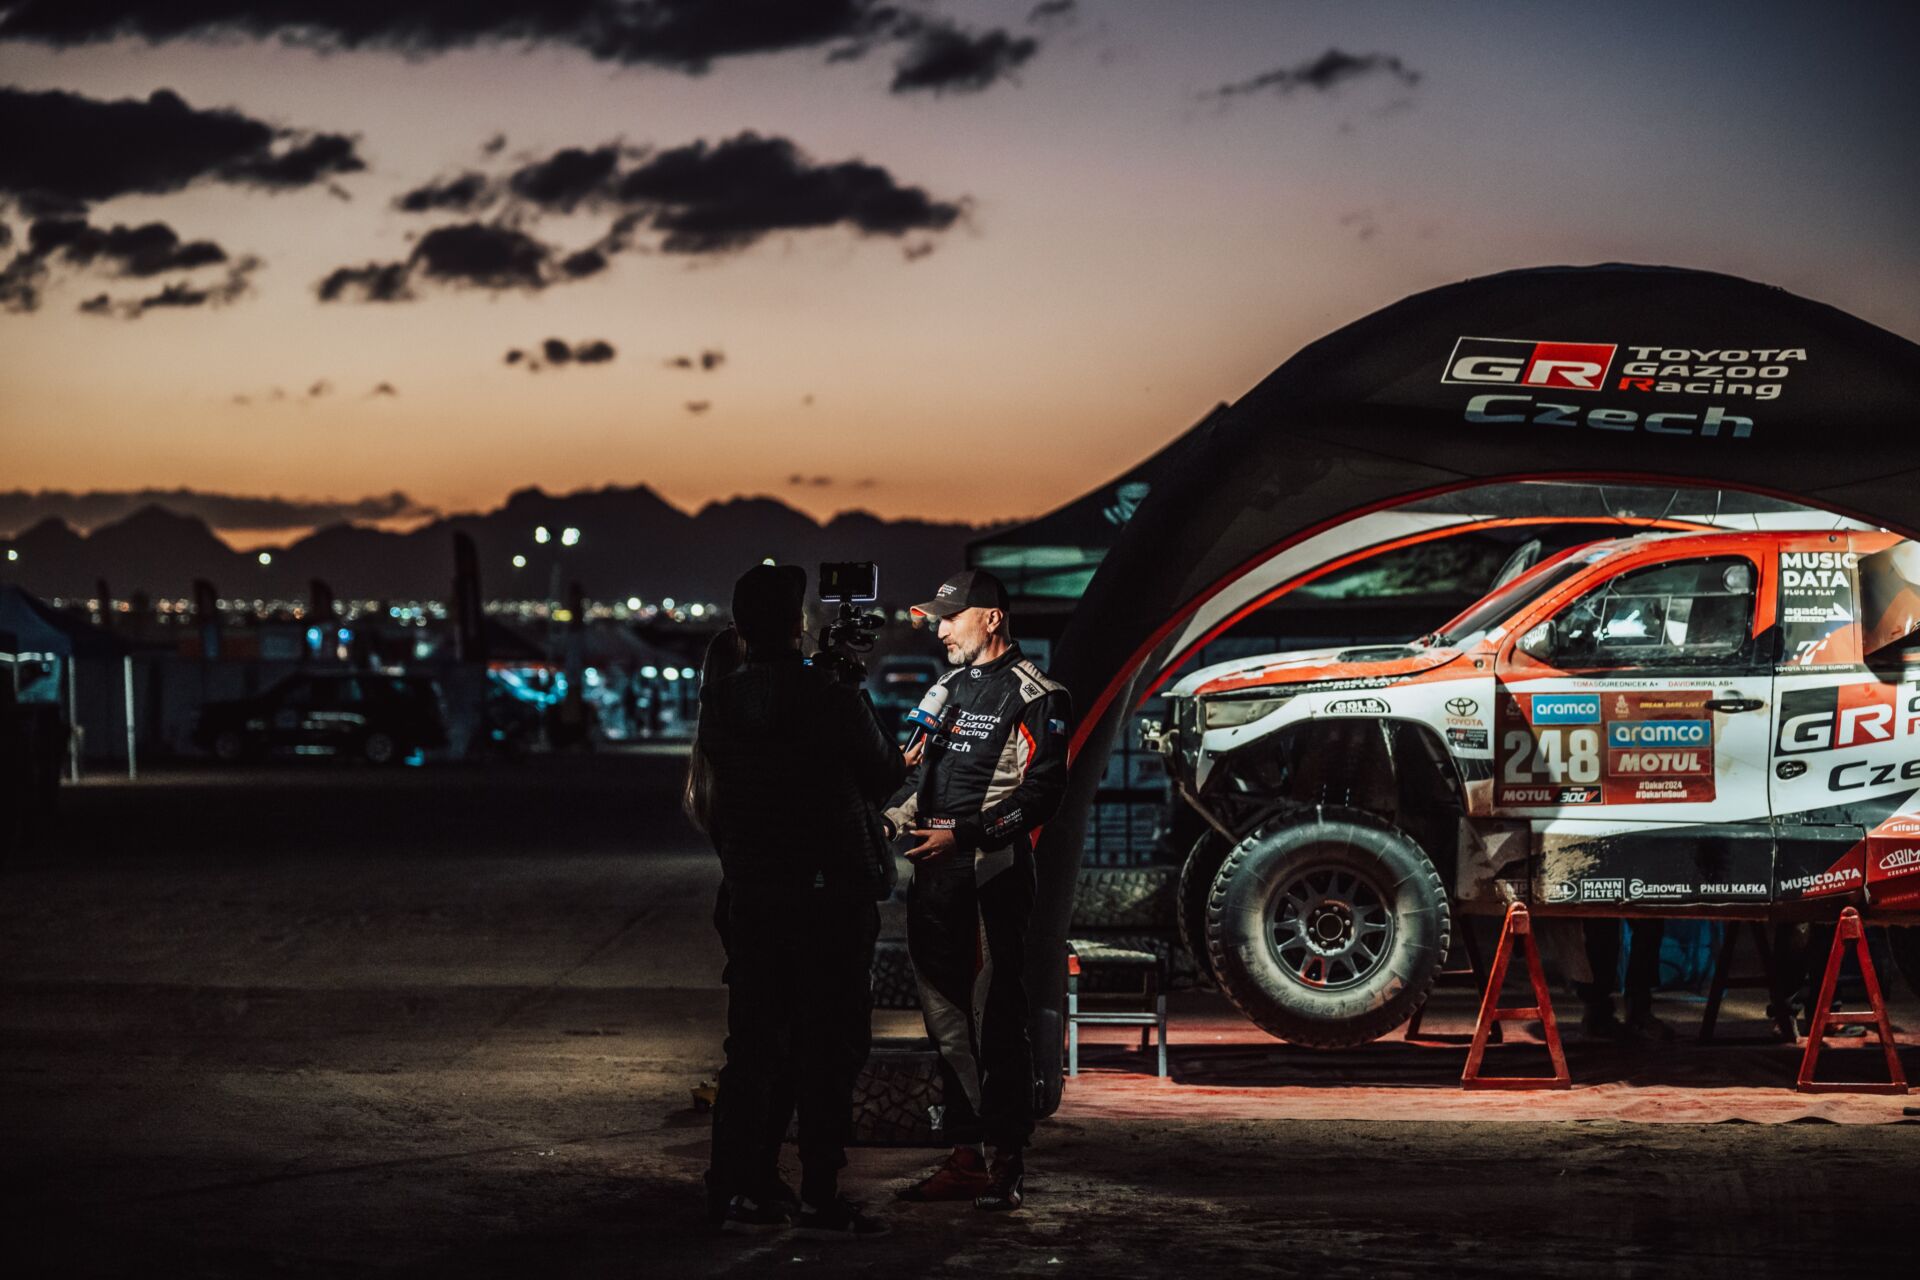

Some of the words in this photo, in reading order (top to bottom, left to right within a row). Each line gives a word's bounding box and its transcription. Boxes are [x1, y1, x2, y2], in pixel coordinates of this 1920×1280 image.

[1628, 346, 1807, 362] TOYOTA
[1452, 356, 1602, 388] GR
[1622, 362, 1789, 378] GAZOO
[1618, 377, 1782, 400] Racing
[1465, 394, 1754, 438] Czech
[1781, 553, 1858, 569] MUSIC
[1782, 570, 1850, 587] DATA
[960, 710, 1001, 724] TOYOTA
[1536, 703, 1597, 715] aramco
[955, 718, 995, 730] GAZOO
[1446, 718, 1484, 727] TOYOTA
[1780, 704, 1893, 752] GR
[951, 725, 990, 740] Racing
[1615, 726, 1704, 742] aramco
[1503, 729, 1600, 783] 248
[1618, 752, 1702, 772] MOTUL
[1639, 780, 1683, 790] #Dakar2024
[1502, 790, 1552, 801] MOTUL
[1560, 790, 1599, 803] 300V
[1583, 881, 1621, 890] MANN
[1780, 867, 1862, 892] MUSICDATA
[1583, 889, 1622, 898] FILTER
[1700, 883, 1729, 894] PNEU
[1732, 883, 1767, 894] KAFKA
